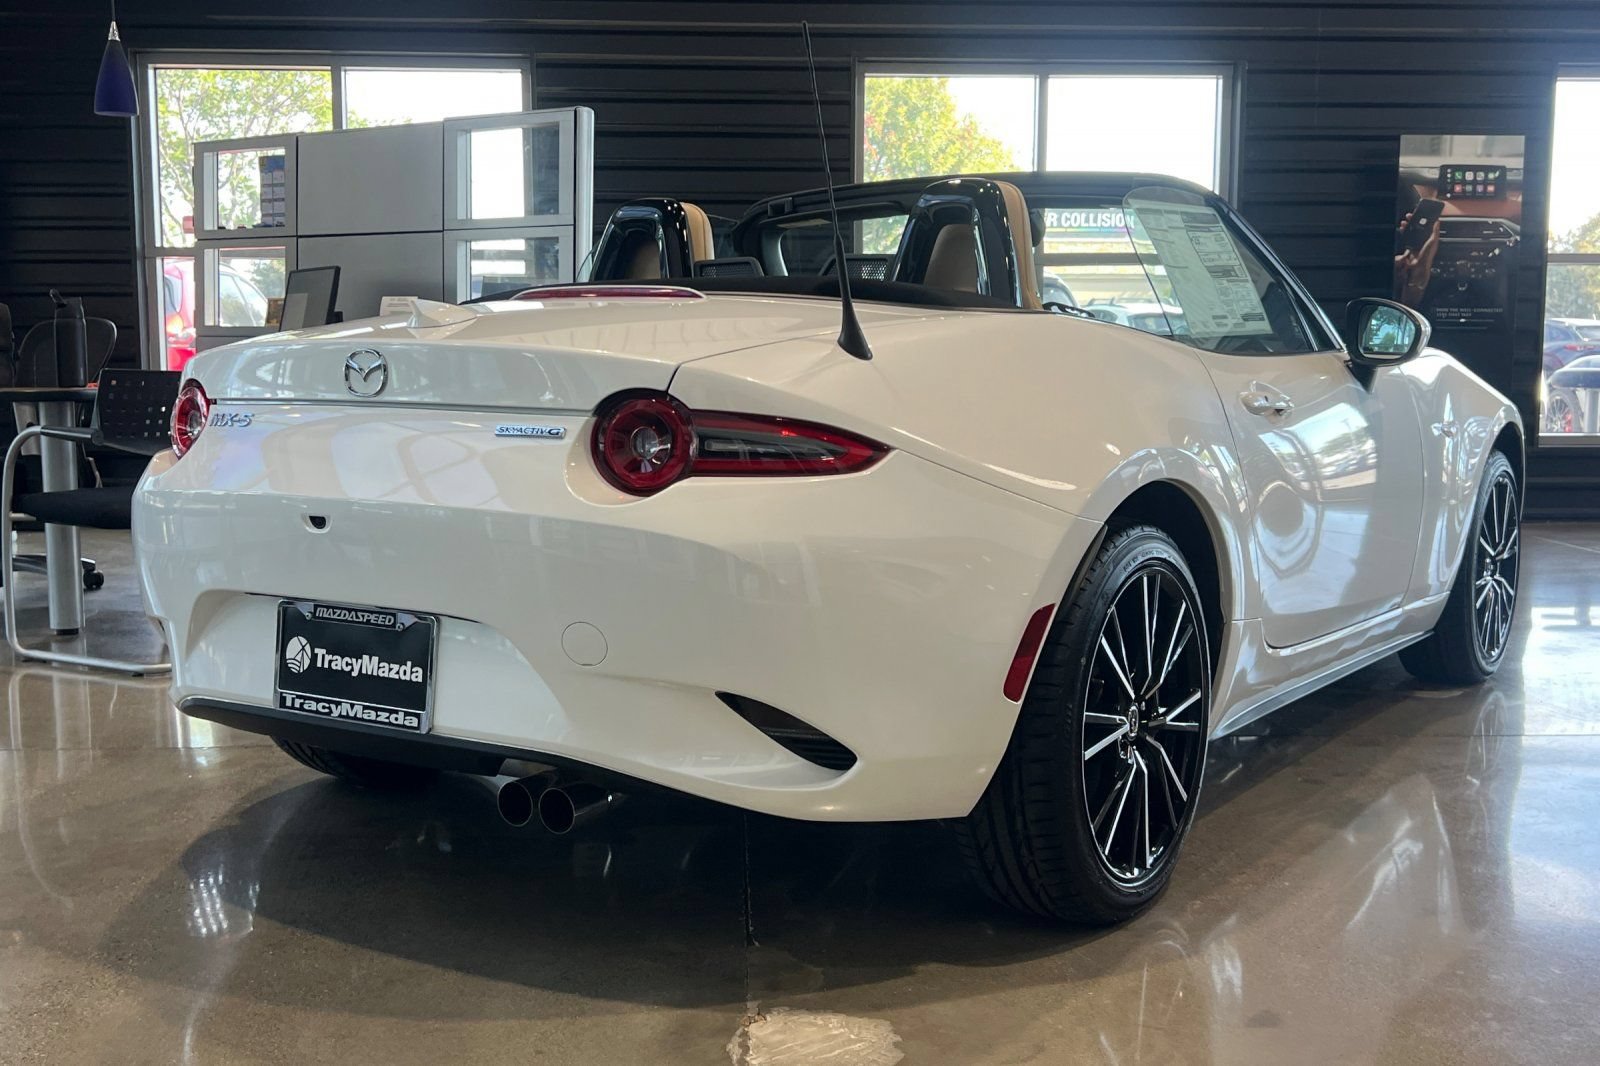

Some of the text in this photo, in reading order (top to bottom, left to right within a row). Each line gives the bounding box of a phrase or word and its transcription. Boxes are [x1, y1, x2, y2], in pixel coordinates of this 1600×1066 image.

[1061, 212, 1135, 229] COLLISION
[209, 413, 255, 428] MX-5
[315, 606, 395, 626] MAZDASPEED
[313, 647, 424, 683] TracyMazda
[282, 693, 418, 727] TracyMazda
